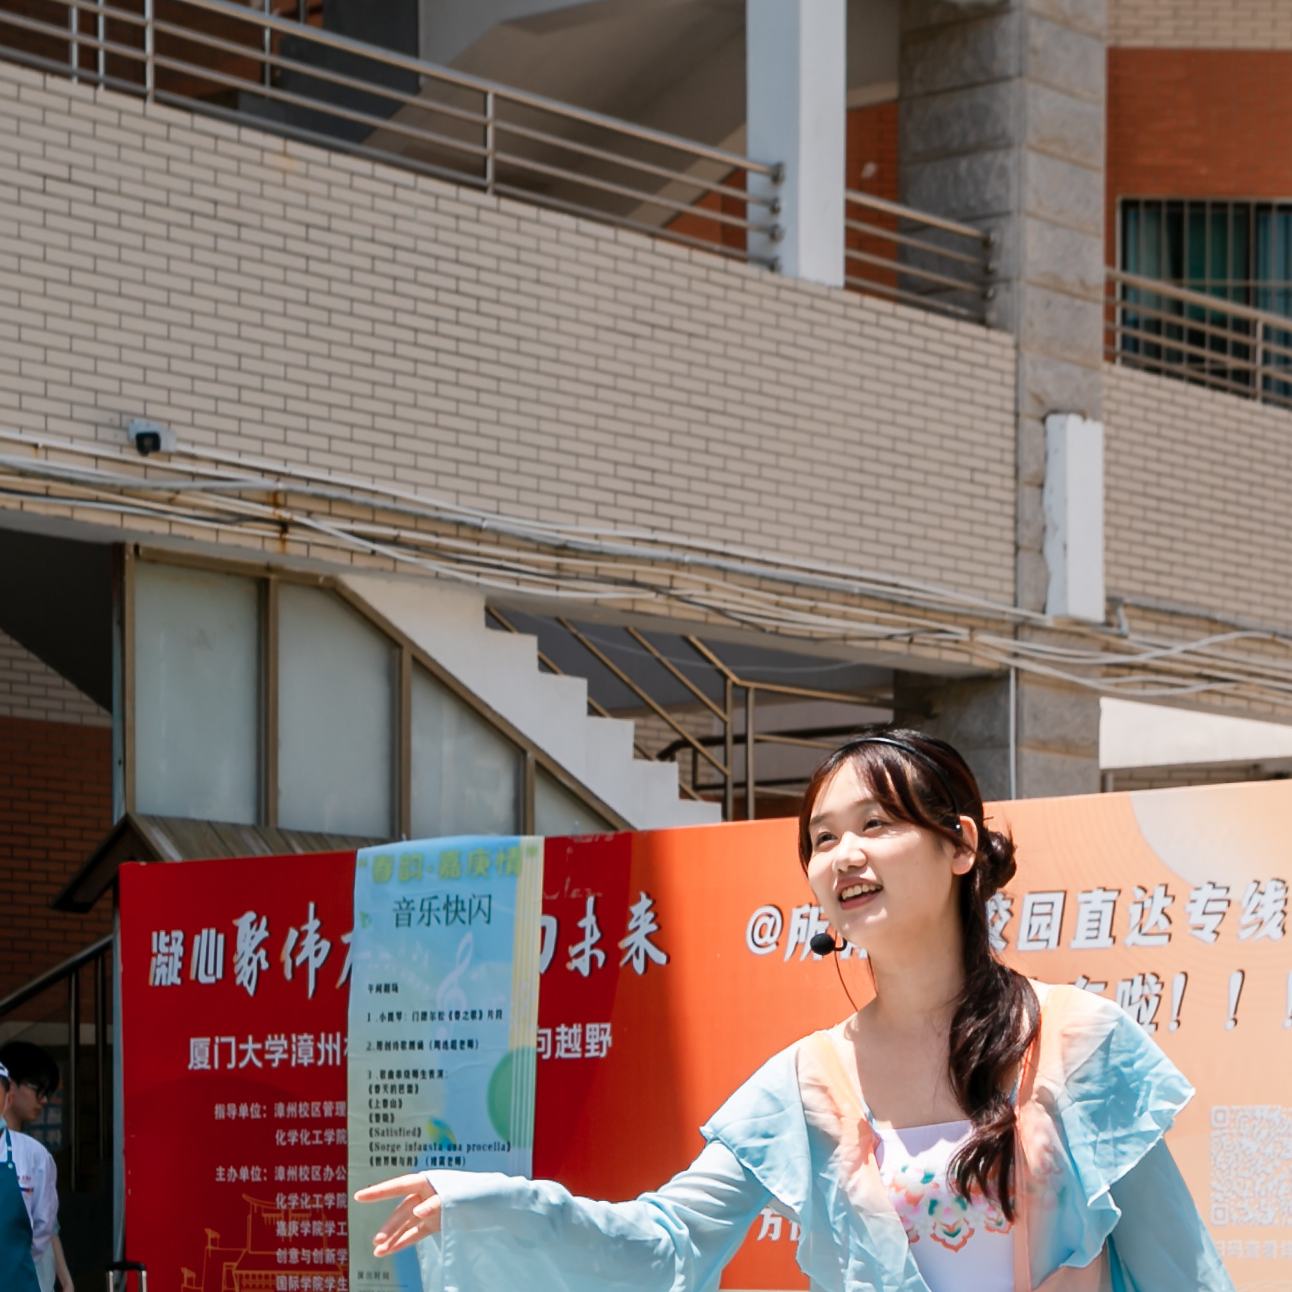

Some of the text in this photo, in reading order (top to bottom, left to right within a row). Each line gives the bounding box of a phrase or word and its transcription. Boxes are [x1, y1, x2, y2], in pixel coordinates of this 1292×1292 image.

[393, 893, 492, 928] 音乐快闪
[188, 1032, 348, 1070] 厦门大学漳州
[275, 1129, 347, 1146] 化学化工学院
[275, 1193, 347, 1209] 化学化工学院
[275, 1220, 347, 1237] 嘉庚学院学工
[275, 1248, 347, 1265] 创意与创新学
[275, 1275, 347, 1292] 国际学院学生
